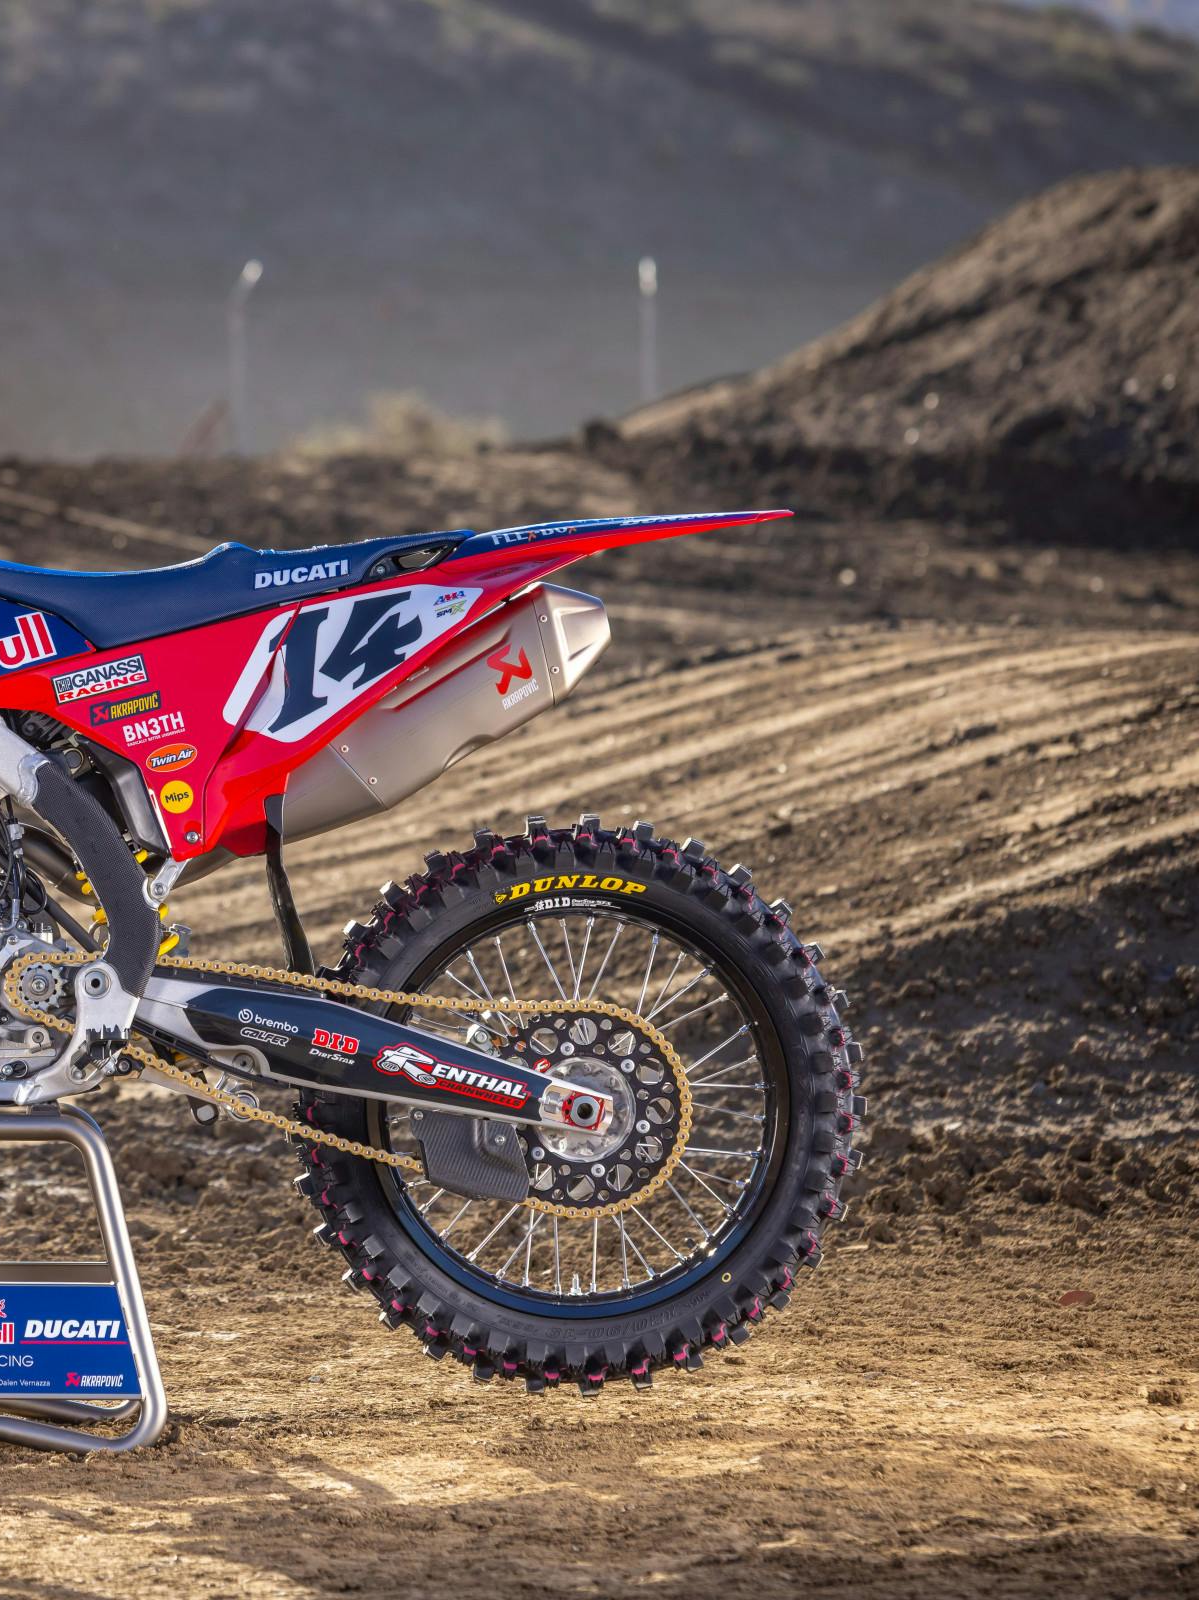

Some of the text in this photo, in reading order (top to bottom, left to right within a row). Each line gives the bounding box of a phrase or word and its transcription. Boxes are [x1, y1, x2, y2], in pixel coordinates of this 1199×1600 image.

[254, 559, 350, 590] DUCATI
[55, 657, 144, 692] CHIP GANASSI
[267, 590, 424, 734] 14
[58, 672, 146, 703] RACING
[122, 711, 185, 743] BN3TH
[151, 748, 195, 769] Twin Air
[164, 790, 190, 804] Mips
[509, 875, 648, 901] DUNLOP
[240, 1027, 290, 1047] GALFER
[255, 1013, 299, 1034] brembo
[376, 1045, 527, 1100] RENTHAL
[437, 1080, 523, 1108] CHAINWHEELS
[23, 1319, 121, 1340] DUCATI
[19, 1378, 51, 1388] Vernazza
